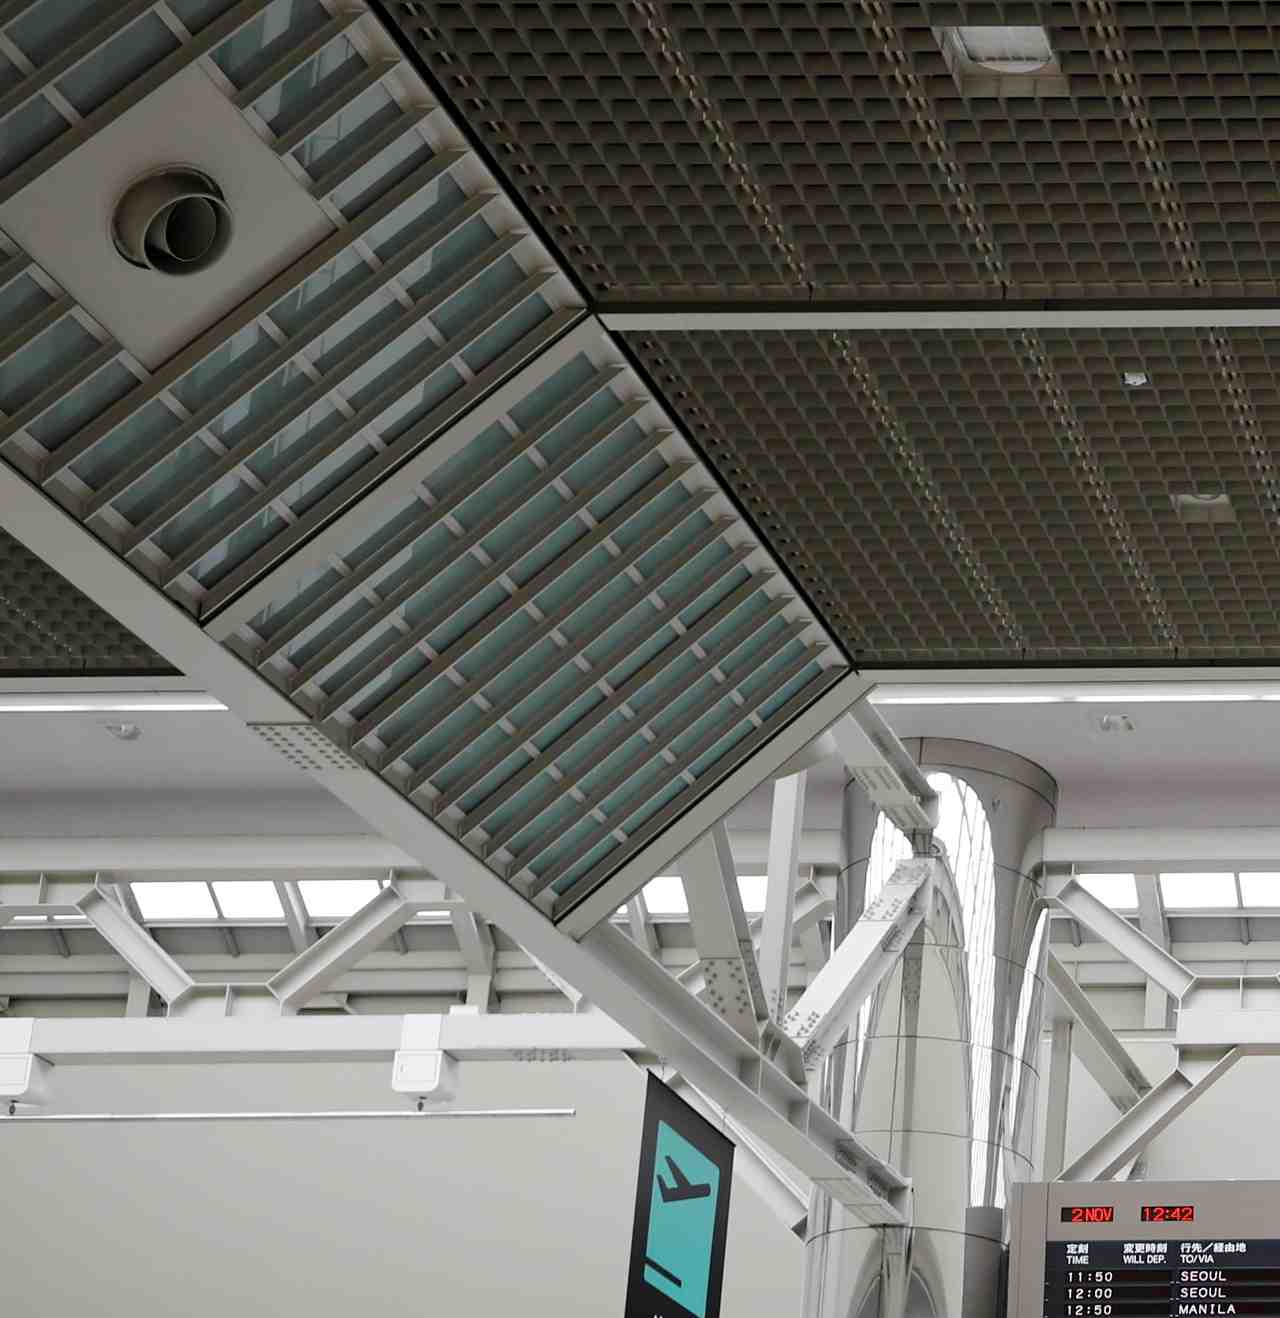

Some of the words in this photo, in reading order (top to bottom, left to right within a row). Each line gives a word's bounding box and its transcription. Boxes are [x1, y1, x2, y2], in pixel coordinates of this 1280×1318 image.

[1071, 1208, 1083, 1222] 2
[1085, 1207, 1113, 1221] NOV
[1143, 1206, 1194, 1221] 12:42
[1066, 1255, 1089, 1265] TIME
[1123, 1255, 1144, 1265] WILL
[1146, 1254, 1168, 1264] DEP.
[1180, 1254, 1214, 1264] TO/VIA
[1068, 1271, 1113, 1283] 11:50
[1180, 1270, 1227, 1282] SEOUL
[1068, 1288, 1113, 1299] 12:00
[1180, 1287, 1226, 1298] SEOUL
[1067, 1304, 1112, 1316] 12:50
[1178, 1303, 1236, 1315] MANILA
